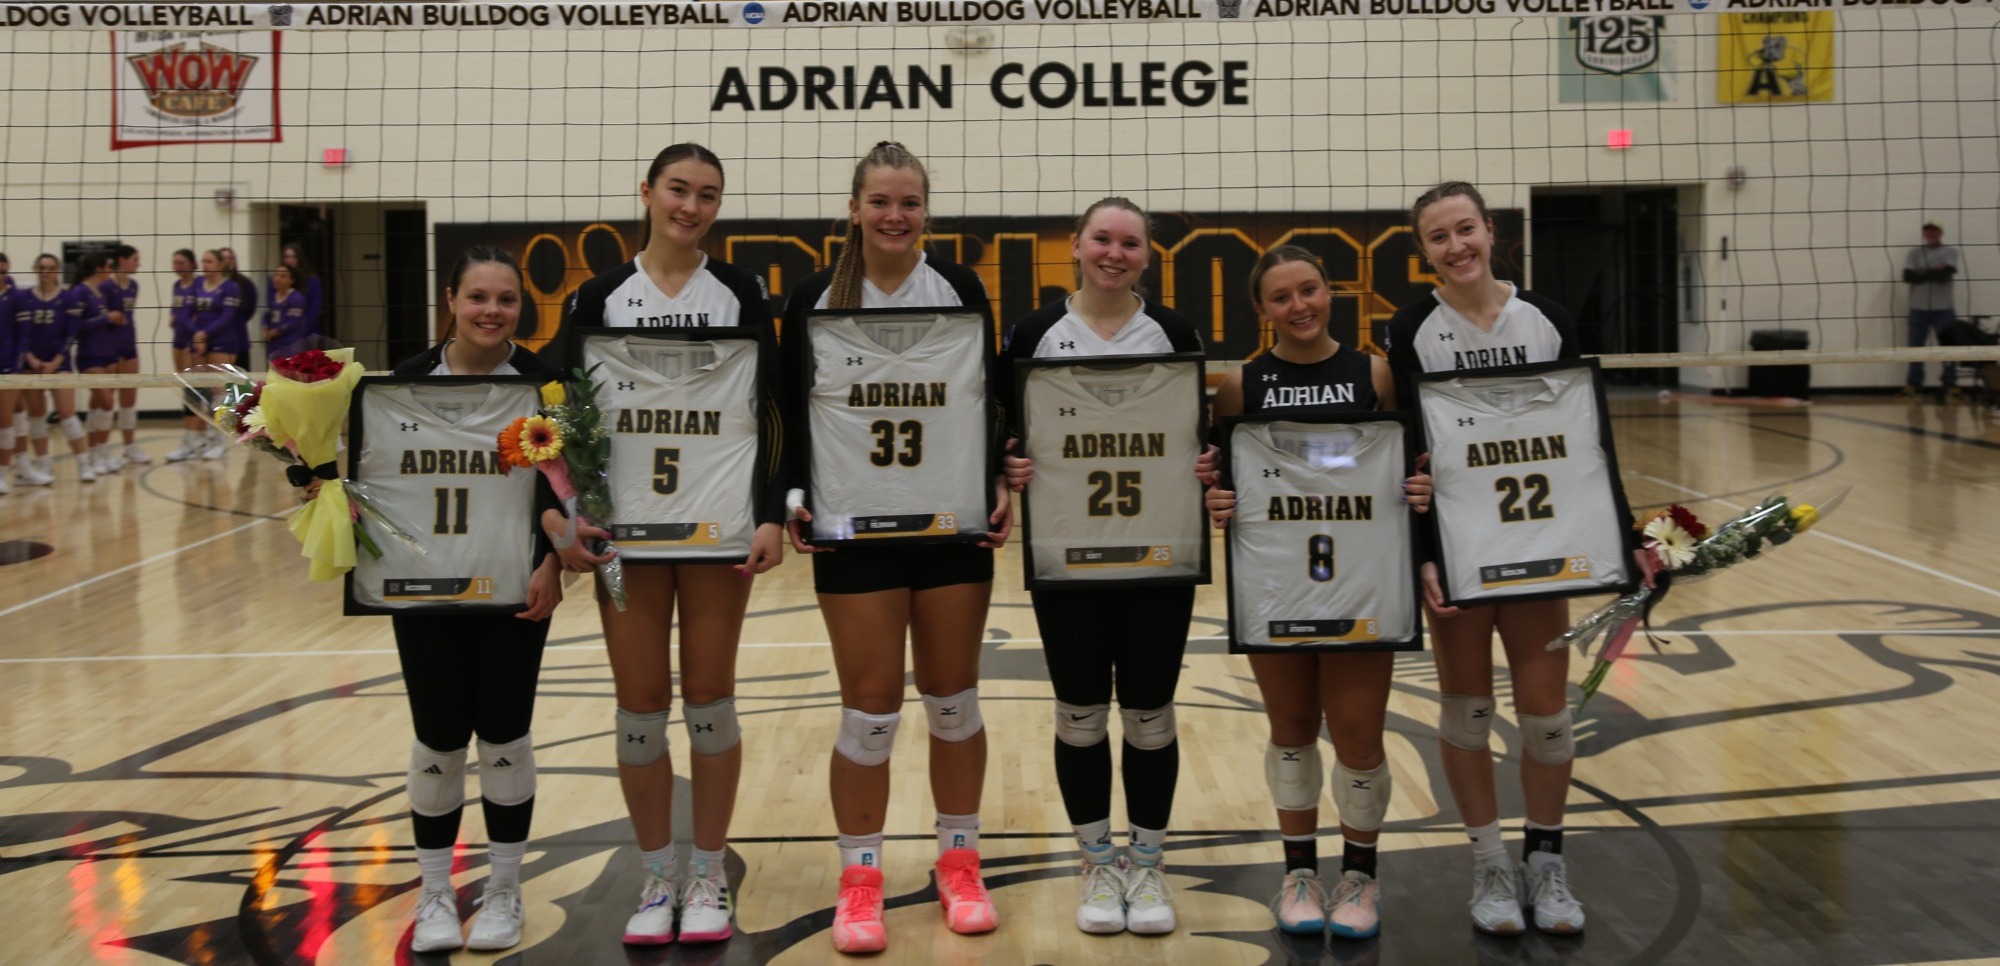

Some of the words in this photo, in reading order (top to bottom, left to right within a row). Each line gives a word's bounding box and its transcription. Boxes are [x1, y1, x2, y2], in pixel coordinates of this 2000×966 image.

[0, 5, 70, 26] DOG
[79, 5, 253, 26] VOLLEYBALL
[306, 5, 412, 26] ADRIAN
[423, 5, 549, 26] BULLDOG
[558, 4, 729, 26] VOLLEYBALL
[782, 2, 888, 23] ADRIAN
[897, 0, 1025, 22] BULLDOG
[1036, 0, 1202, 20] VOLLEYBALL
[1254, 0, 1360, 17] ADRIAN
[1369, 0, 1496, 15] BULLDOG
[1584, 16, 1651, 54] 125
[135, 47, 252, 98] WOW
[711, 65, 953, 111] ADRIAN
[989, 60, 1249, 109] COLLEGE
[33, 309, 55, 325] 22
[1453, 345, 1528, 371] ADRIAN
[847, 382, 947, 408] ADRIAN
[1262, 383, 1355, 408] ADRIAN
[616, 408, 722, 436] ADRIAN
[869, 419, 923, 468] 33
[1062, 432, 1166, 459] ADRIAN
[1466, 434, 1568, 468] ADRIAN
[400, 449, 508, 475] ADRIAN
[652, 447, 681, 496] 5
[1087, 470, 1142, 517] 25
[1494, 473, 1555, 523] 22
[432, 486, 470, 535] 11
[1267, 495, 1373, 521] ADRIAN
[709, 524, 718, 539] 5
[937, 515, 956, 530] 33
[1153, 547, 1169, 561] 25
[1308, 534, 1335, 583] 8
[1569, 557, 1588, 573] 22
[476, 579, 491, 594] 11
[1367, 620, 1376, 635] 8
